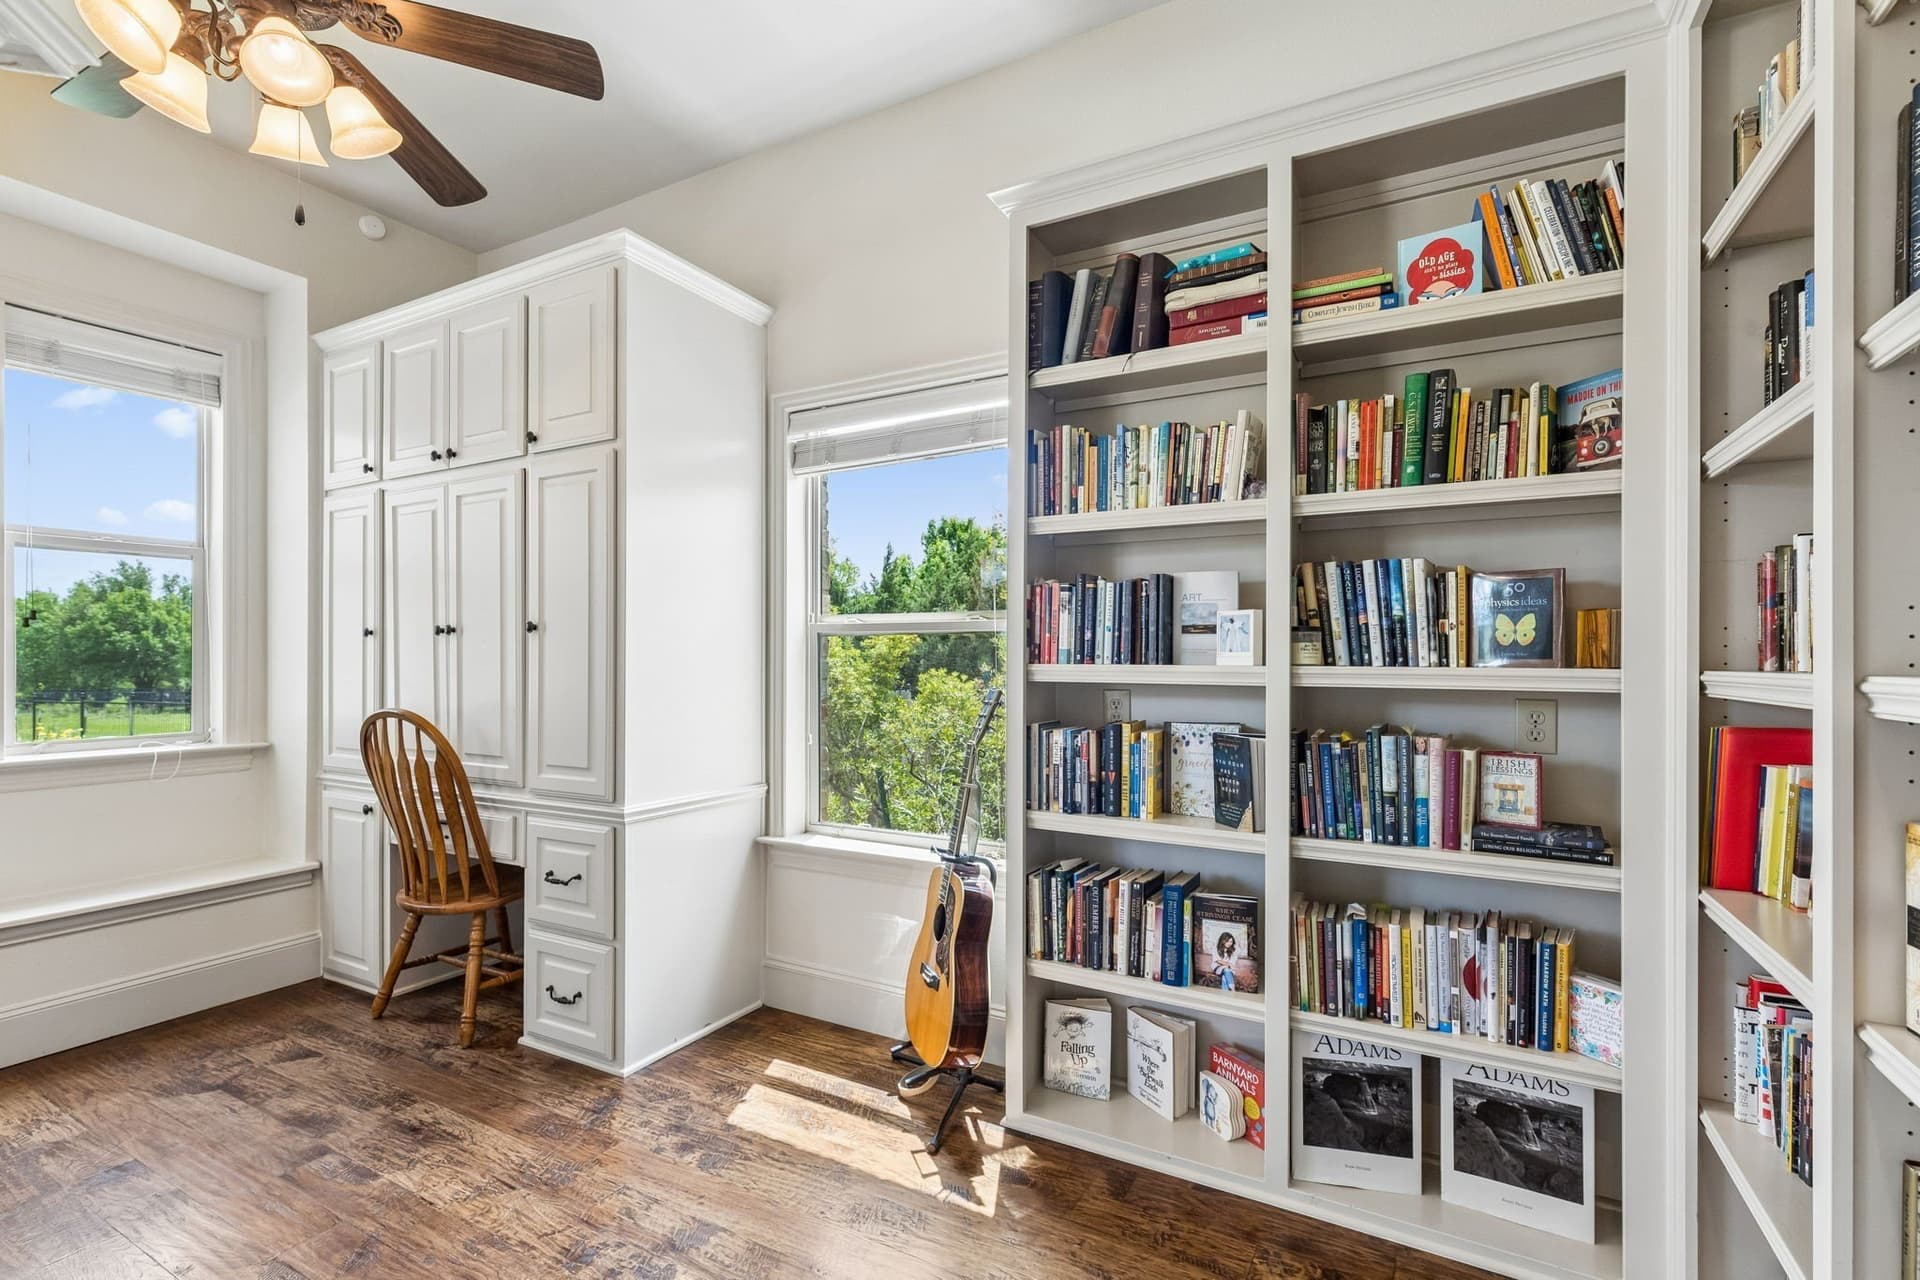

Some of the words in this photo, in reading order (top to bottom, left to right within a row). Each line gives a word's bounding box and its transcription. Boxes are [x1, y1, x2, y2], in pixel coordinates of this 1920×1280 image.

[1561, 190, 1575, 218] Learning
[1572, 218, 1584, 244] Humility
[1544, 206, 1560, 236] CELEBRATION
[1556, 240, 1574, 268] DISCIPLINE
[1418, 256, 1435, 269] OLD
[1438, 251, 1455, 264] AGE
[1440, 267, 1466, 278] sissies
[1198, 326, 1226, 334] APPLICATION
[1780, 336, 1788, 376] Paul
[1597, 384, 1606, 396] ON
[1408, 392, 1416, 408] C.S.
[1407, 409, 1415, 433] LEWIS
[1433, 406, 1441, 429] LEWIS
[1343, 568, 1352, 599] GRACE
[1355, 568, 1363, 593] LUCADO
[1504, 582, 1525, 597] 50
[1485, 597, 1520, 608] physics
[1521, 596, 1548, 606] ideas
[1486, 765, 1533, 776] BLESSINGS
[1491, 758, 1526, 768] IRISH
[1060, 1041, 1096, 1058] Falling
[1312, 1034, 1403, 1061] ADAMS
[1070, 1053, 1088, 1068] Up
[1142, 1052, 1160, 1070] Where
[1212, 1052, 1259, 1085] BARNYARD
[1144, 1078, 1158, 1093] Ends
[1216, 1066, 1256, 1096] ANIMALS
[1465, 1064, 1570, 1097] ADAMS
